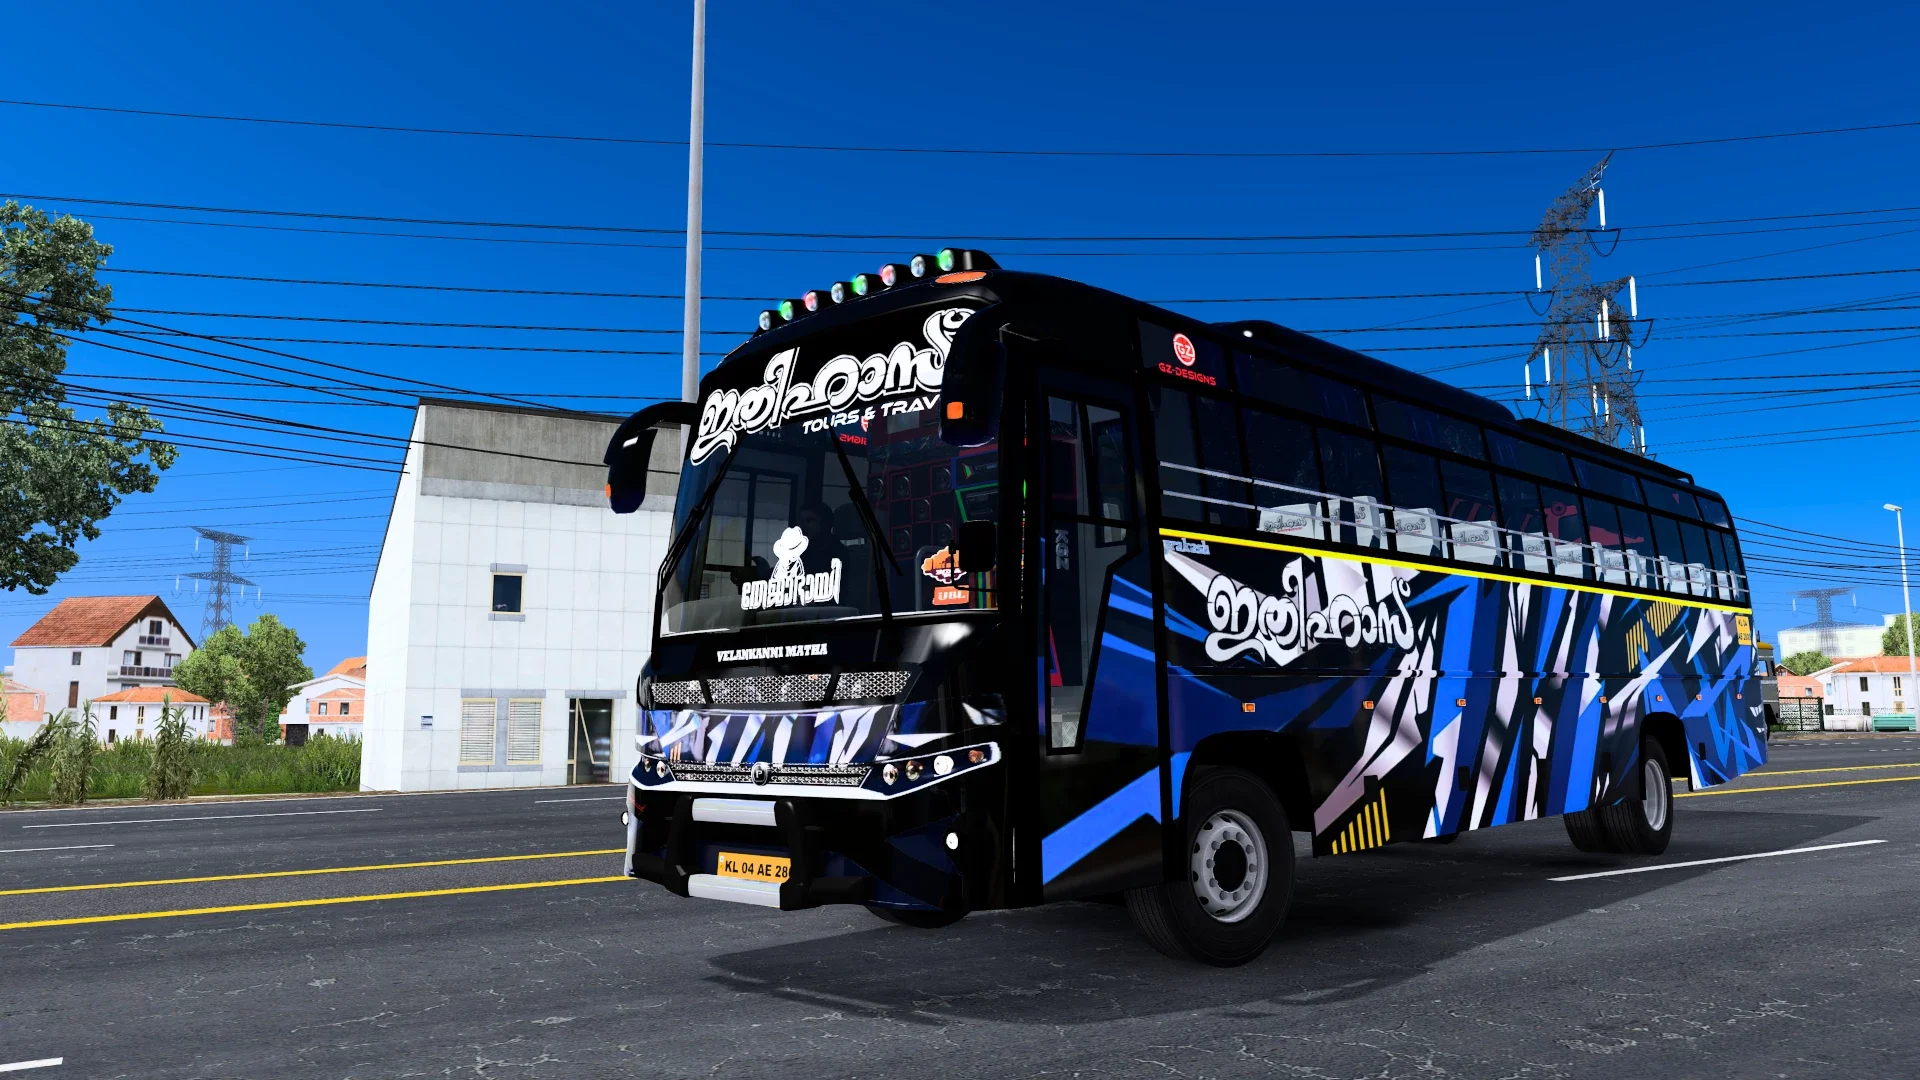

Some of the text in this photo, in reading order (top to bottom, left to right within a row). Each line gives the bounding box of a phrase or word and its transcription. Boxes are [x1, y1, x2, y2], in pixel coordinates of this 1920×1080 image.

[1158, 362, 1217, 386] GZ-DESIGNS
[802, 395, 941, 435] TOURS & TRAV
[1205, 557, 1415, 662] ഇതിഹാസ്
[717, 643, 828, 663] VELANKANNI MATHA
[725, 860, 791, 878] KL 04 AE 28
